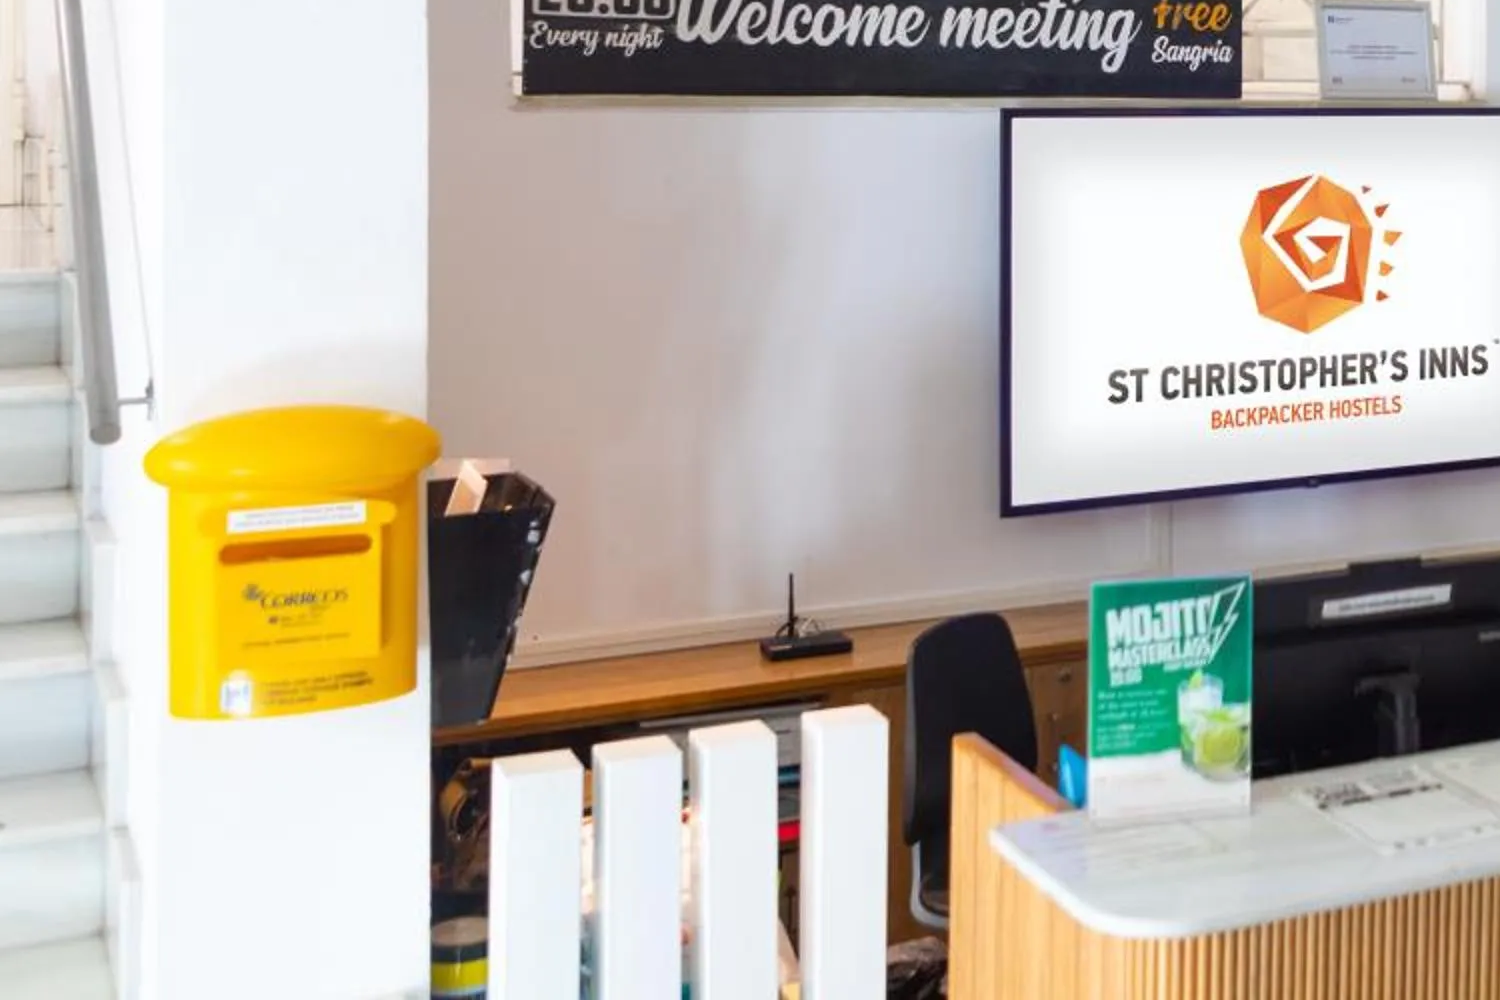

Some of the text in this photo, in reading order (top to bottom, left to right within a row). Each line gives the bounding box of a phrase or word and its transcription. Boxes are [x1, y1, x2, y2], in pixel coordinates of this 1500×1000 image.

[529, 20, 666, 56] Every night
[1151, 35, 1235, 72] Sangria
[1107, 344, 1490, 404] ST CHRISTOPHER'S INNS
[1211, 395, 1402, 430] BACKPACKER HOSTELS
[1106, 596, 1214, 647] MOJITO
